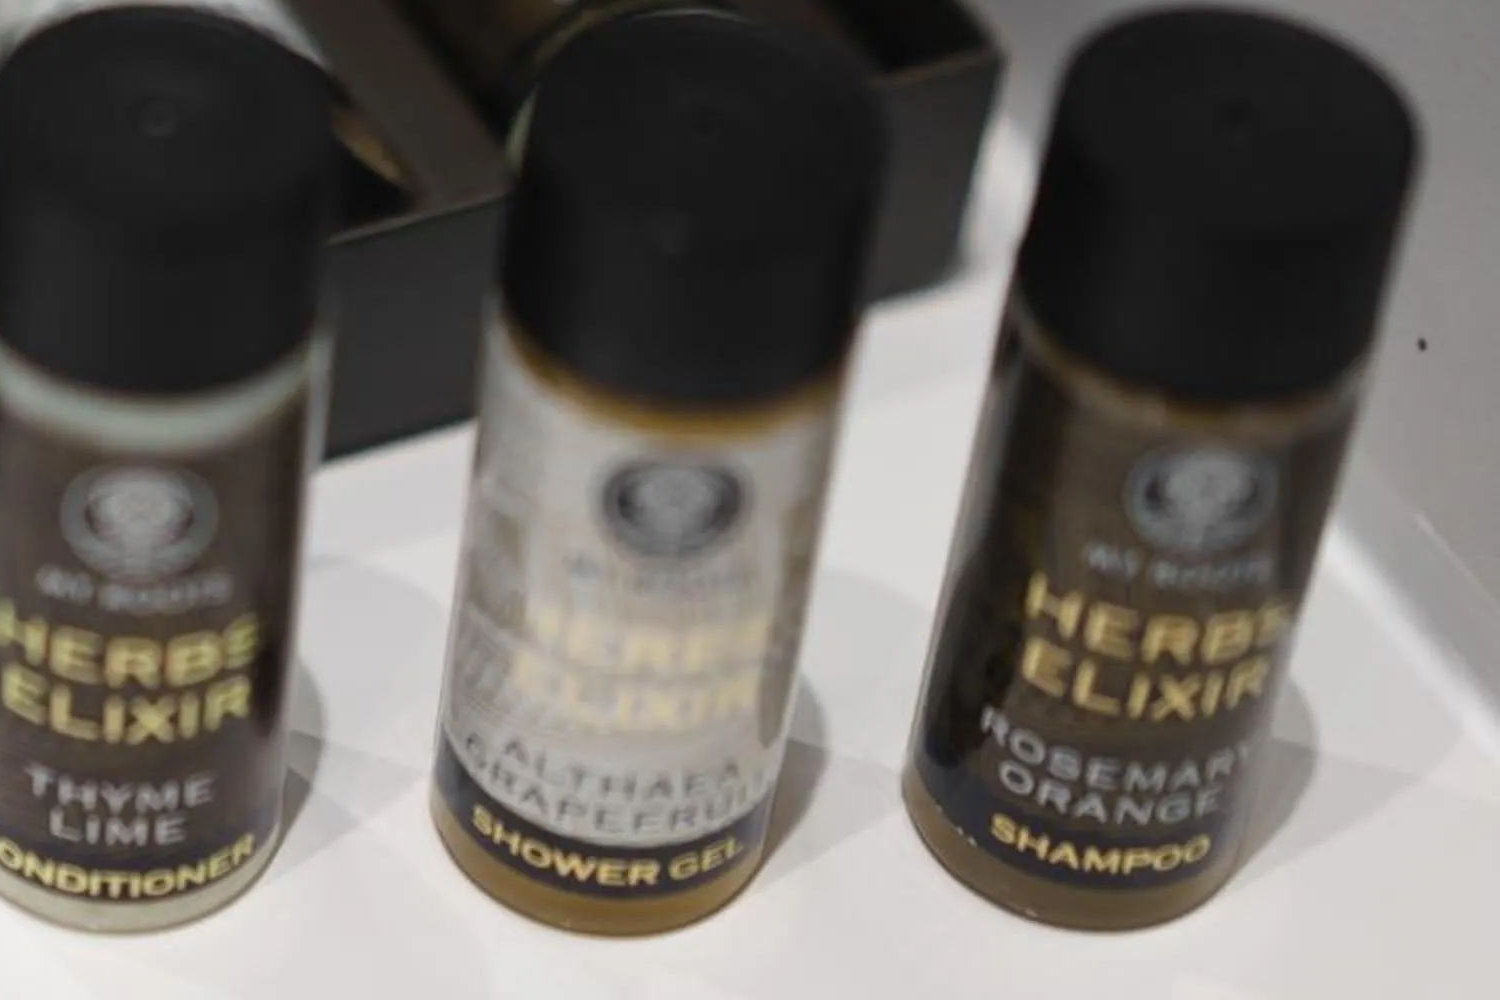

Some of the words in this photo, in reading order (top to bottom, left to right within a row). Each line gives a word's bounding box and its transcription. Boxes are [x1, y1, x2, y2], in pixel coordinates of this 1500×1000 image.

[0, 661, 252, 746] ELIXIR
[1020, 639, 1272, 722] ELIXIR
[26, 760, 216, 813] THYME
[503, 735, 740, 803] ALTHAEA
[999, 762, 1224, 826] ORANGE
[49, 806, 189, 847] LIME
[471, 804, 661, 887] SHOWER
[668, 837, 743, 882] GEL
[989, 812, 1212, 876] SHAMPOO
